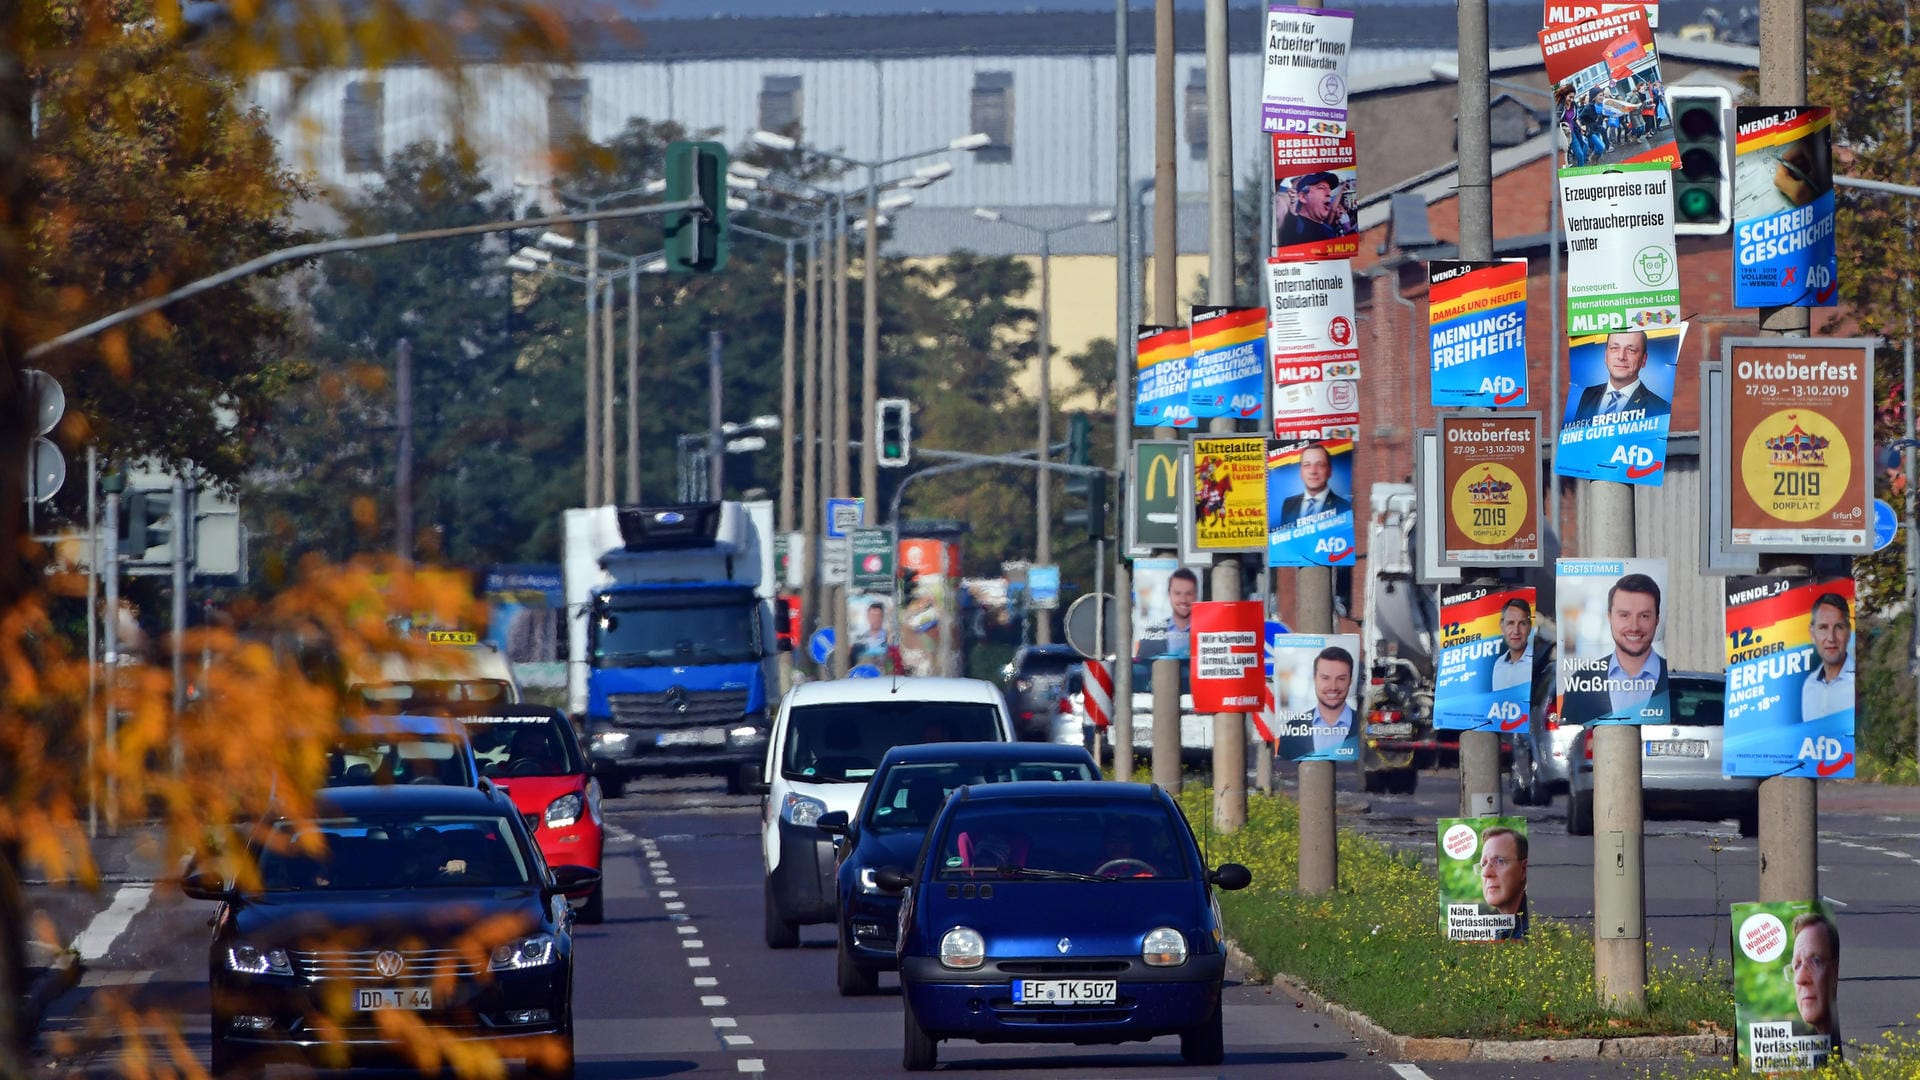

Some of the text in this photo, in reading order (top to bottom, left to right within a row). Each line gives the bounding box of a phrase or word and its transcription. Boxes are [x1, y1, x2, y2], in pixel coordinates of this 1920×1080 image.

[1549, 6, 1598, 23] MLPD
[1270, 20, 1315, 34] Politik für
[1543, 10, 1641, 45] ARBEITERPARTEI
[1546, 42, 1567, 56] DER
[1568, 25, 1629, 49] ZUKUNFT!
[1269, 54, 1337, 70] statt Milliardäre
[1264, 117, 1307, 131] MLPD
[1278, 138, 1340, 148] REBELLION
[1278, 147, 1352, 158] GEGEN DIE EU
[1565, 180, 1666, 202] Erzeugerpreise rauf
[1568, 212, 1664, 232] Verbraucherpreise
[1739, 205, 1814, 246] SCHREIB
[1571, 237, 1598, 252] runter
[1740, 212, 1834, 266] GESCHICHTE!
[1335, 243, 1356, 253] MLPD
[1273, 267, 1301, 277] Hoch die
[1805, 265, 1830, 288] AfD
[1274, 275, 1343, 293] internationale
[1572, 282, 1618, 293] Konsequent.
[1275, 293, 1328, 310] Solidarität
[1433, 290, 1522, 321] DAMALS UND HEUTE:
[1572, 294, 1676, 310] Internationalistische Liste
[1572, 312, 1623, 332] MLPD
[1433, 312, 1523, 349] MEINUNGS-
[1198, 344, 1253, 367] FRIEDLICHE
[1433, 325, 1523, 372] FREIHEIT!
[1156, 358, 1187, 375] BOCK
[1278, 366, 1321, 381] MLPD
[1738, 361, 1857, 381] Oktoberfest
[1479, 376, 1515, 394] AfD
[1746, 384, 1849, 397] 27.09. 13.10.2019
[1231, 395, 1256, 407] AfD
[1164, 405, 1189, 418] AfD
[1564, 408, 1646, 433] MAREK ERFURTH
[1448, 427, 1530, 442] Oktoberfest
[1561, 418, 1659, 445] EINE GUTE WAHL!
[1198, 443, 1260, 454] Mittelalter
[1454, 445, 1525, 454] 27.09. 13.10.2019
[1610, 445, 1654, 466] AfD
[1773, 472, 1820, 496] 2019
[1772, 501, 1820, 511] DOMPLATZ
[1474, 508, 1506, 526] 2019
[1832, 511, 1852, 520] Erfurt
[1315, 538, 1347, 553] AfD
[1563, 564, 1619, 573] ERSTSTIMME
[1443, 622, 1466, 637] 12.
[1443, 633, 1481, 648] OKTOBER
[1730, 628, 1763, 650] 12.
[1232, 655, 1255, 666] Lügen
[1442, 639, 1503, 666] ERFURT
[1730, 641, 1785, 665] OKTOBER
[1440, 663, 1466, 676] ANGER
[1563, 657, 1609, 671] Niklas
[1730, 648, 1814, 691] ERFURT
[1564, 676, 1656, 692] Waßmann
[1729, 686, 1765, 704] ANGER
[1280, 711, 1313, 721] Niklas
[1488, 701, 1520, 719] AfD
[1639, 708, 1664, 717] CDU
[1279, 724, 1349, 736] Waßmann
[1799, 736, 1842, 760] AfD
[1450, 907, 1476, 917] Nähe.
[1450, 917, 1514, 927] Verlässlichkeit.
[1450, 929, 1493, 938] Offenheit.
[1024, 983, 1114, 998] EF TK 507
[361, 991, 430, 1008] DD T 44
